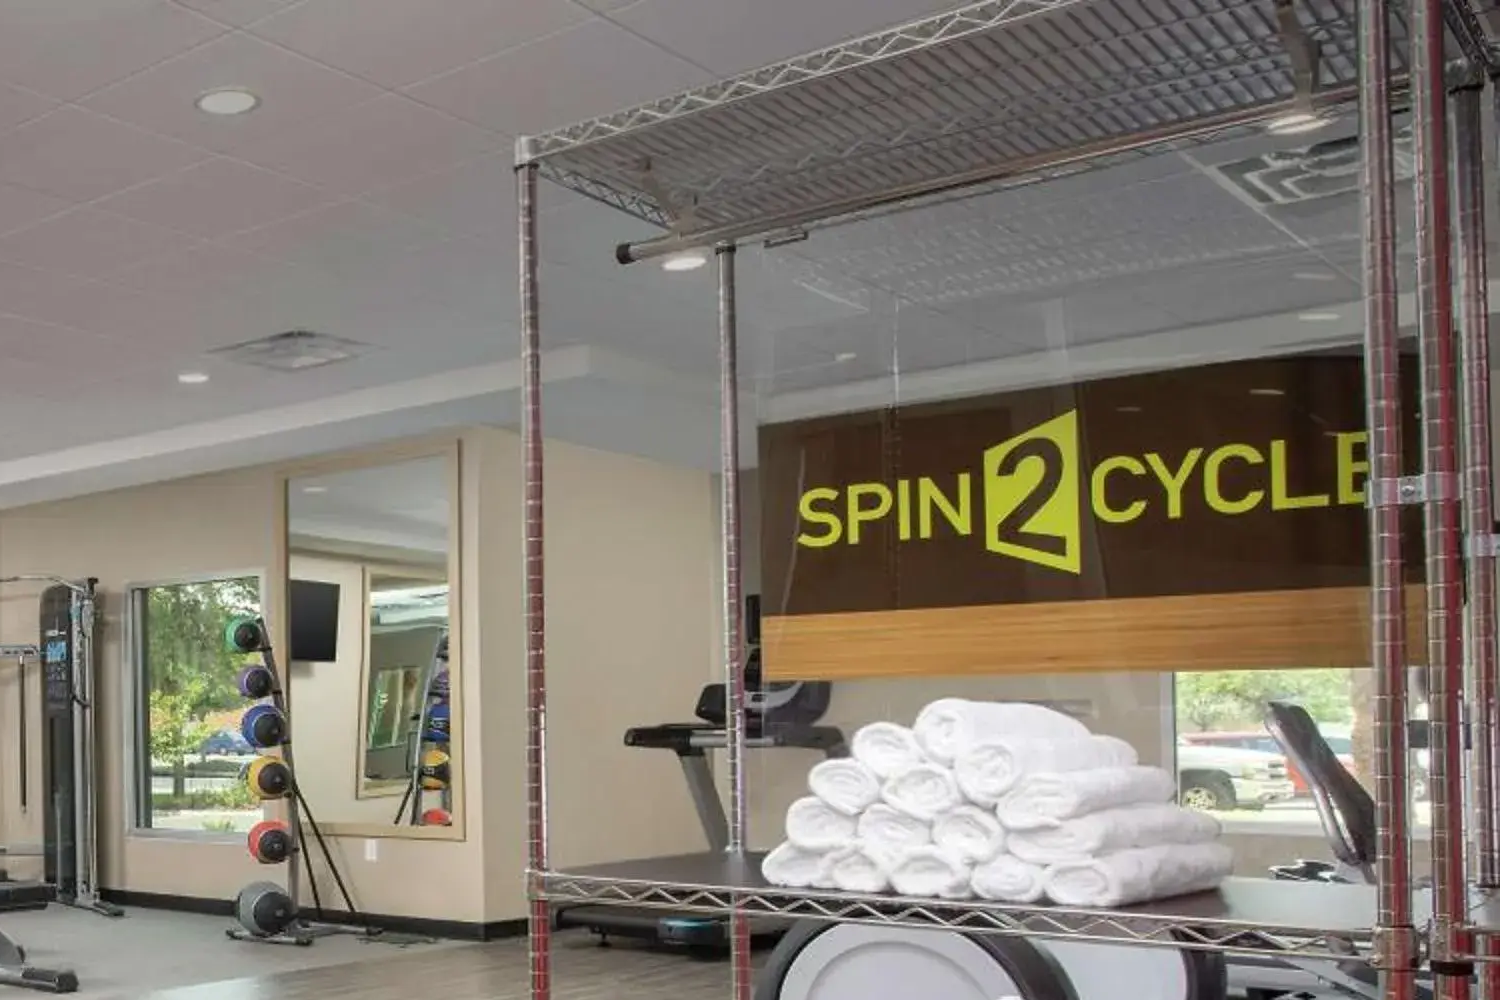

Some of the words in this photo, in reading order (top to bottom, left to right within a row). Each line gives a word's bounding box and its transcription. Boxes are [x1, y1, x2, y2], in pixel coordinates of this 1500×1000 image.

[798, 473, 973, 548] SPIN
[993, 432, 1071, 562] 2
[1091, 431, 1370, 523] CYCLE
